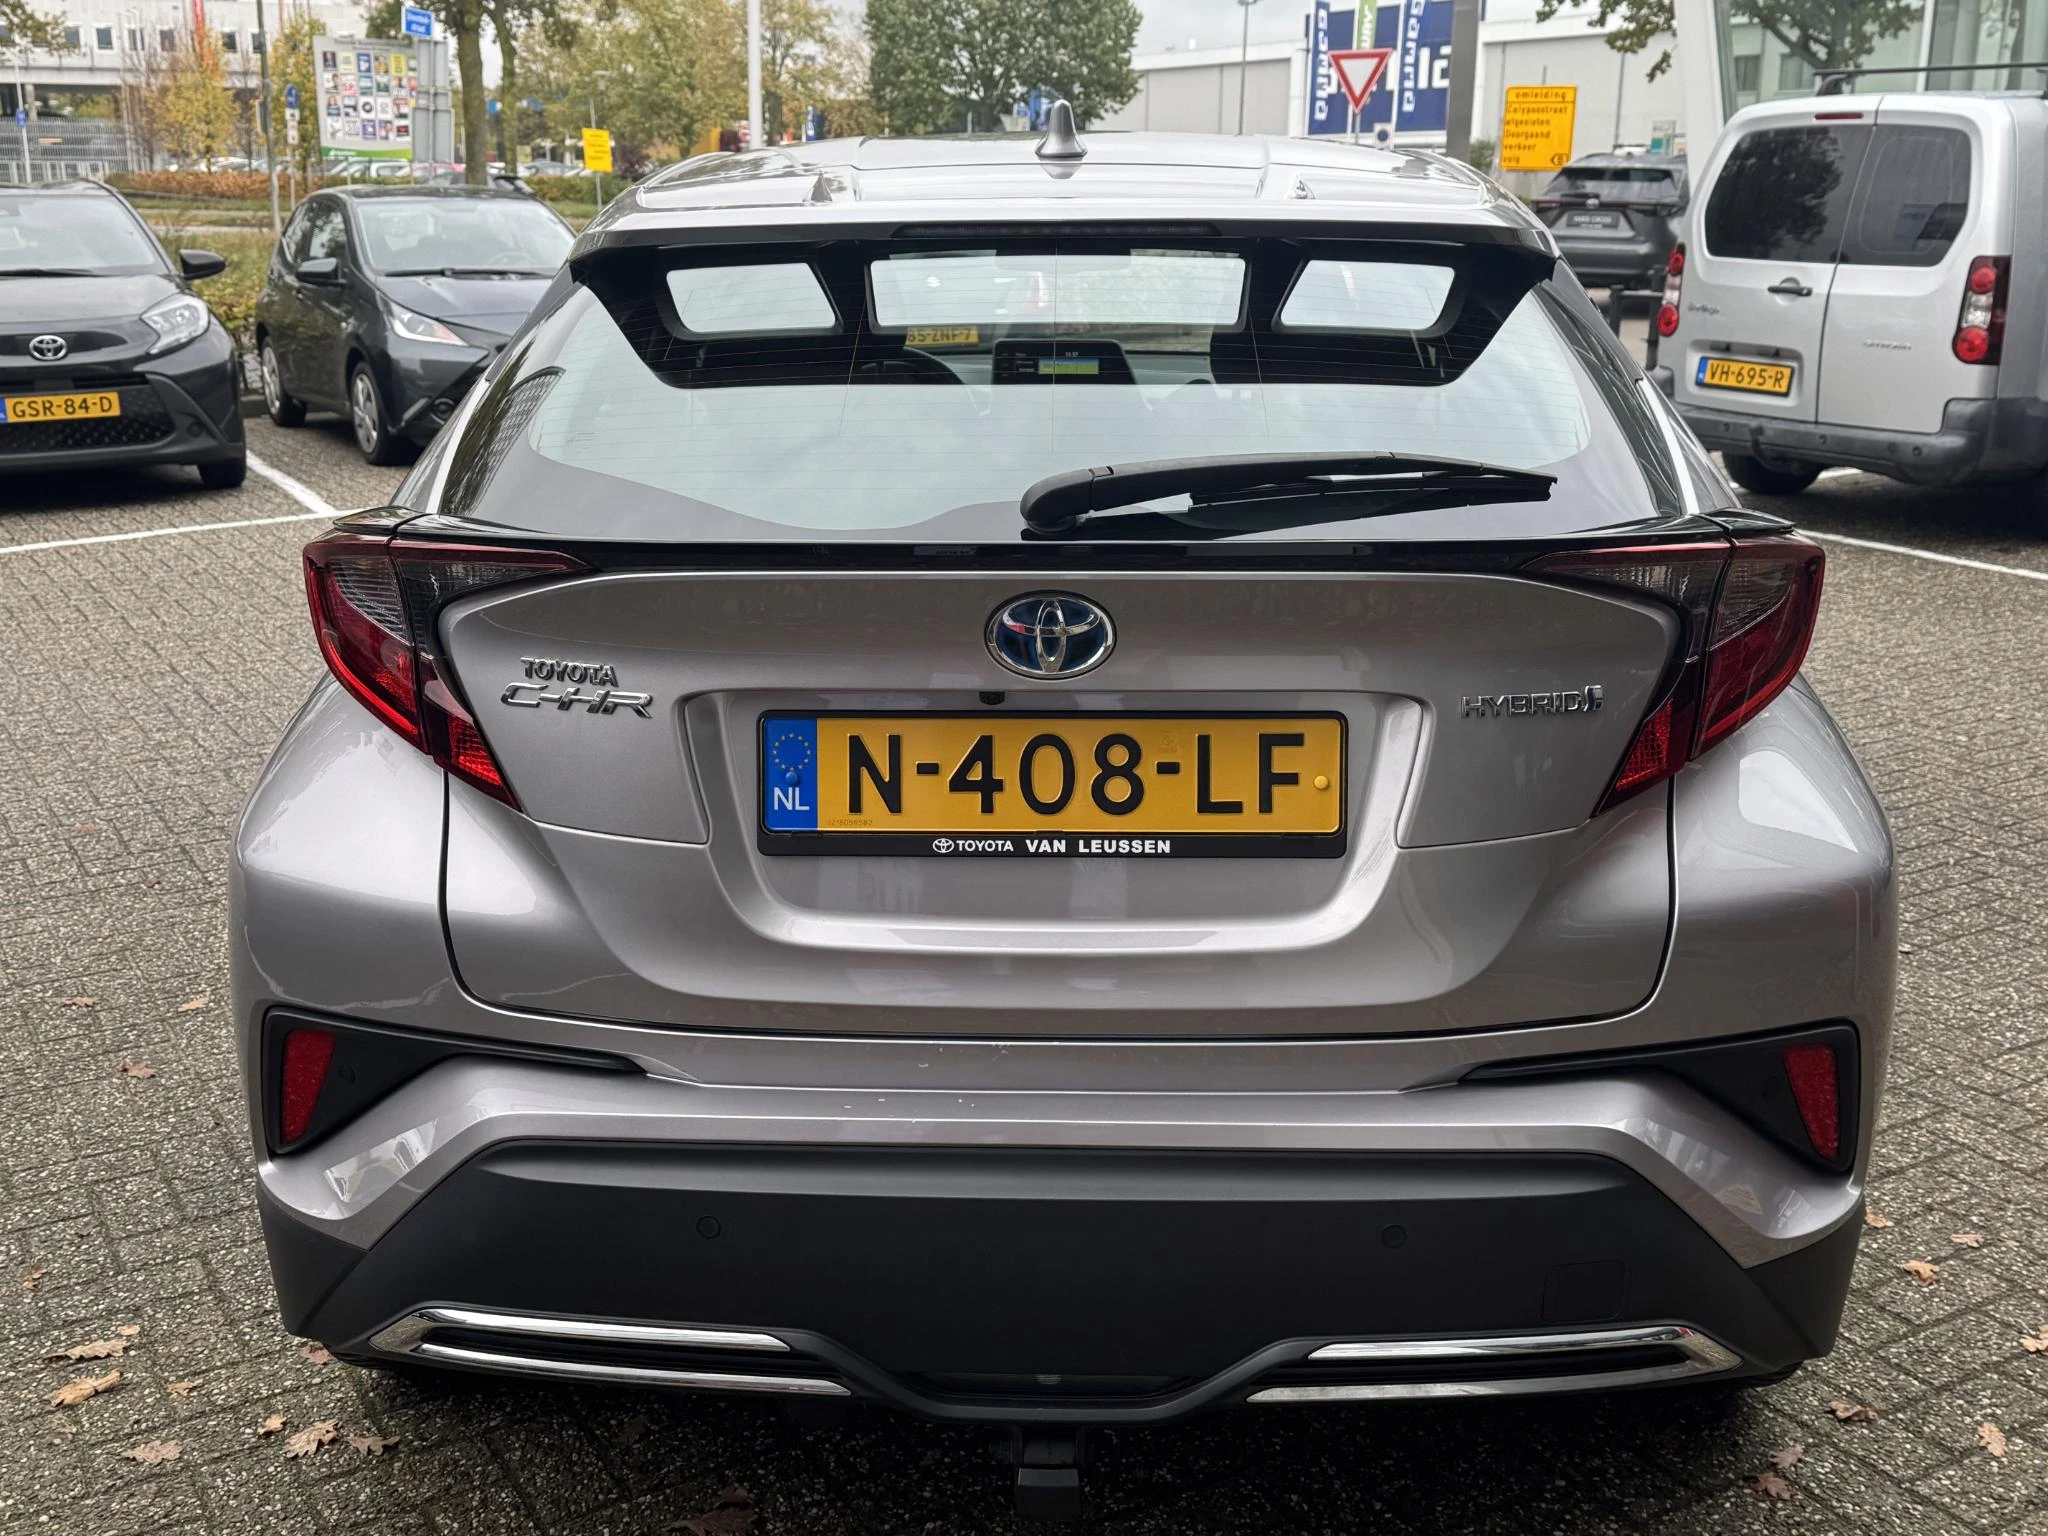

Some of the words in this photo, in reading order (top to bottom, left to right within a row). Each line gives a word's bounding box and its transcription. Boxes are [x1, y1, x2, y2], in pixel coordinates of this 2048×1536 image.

[1515, 91, 1567, 102] omleiding
[1709, 362, 1784, 388] VH-695-R
[12, 396, 113, 418] GSR-84-D
[520, 656, 619, 687] TOYOTA
[501, 682, 653, 718] C-HR
[1460, 690, 1582, 718] HYBRID
[848, 733, 1305, 815] N-408-LF
[773, 787, 810, 811] NL
[957, 840, 1014, 852] TOYOTA
[1025, 839, 1067, 853] VAN
[1078, 839, 1171, 853] LEUSSEN
